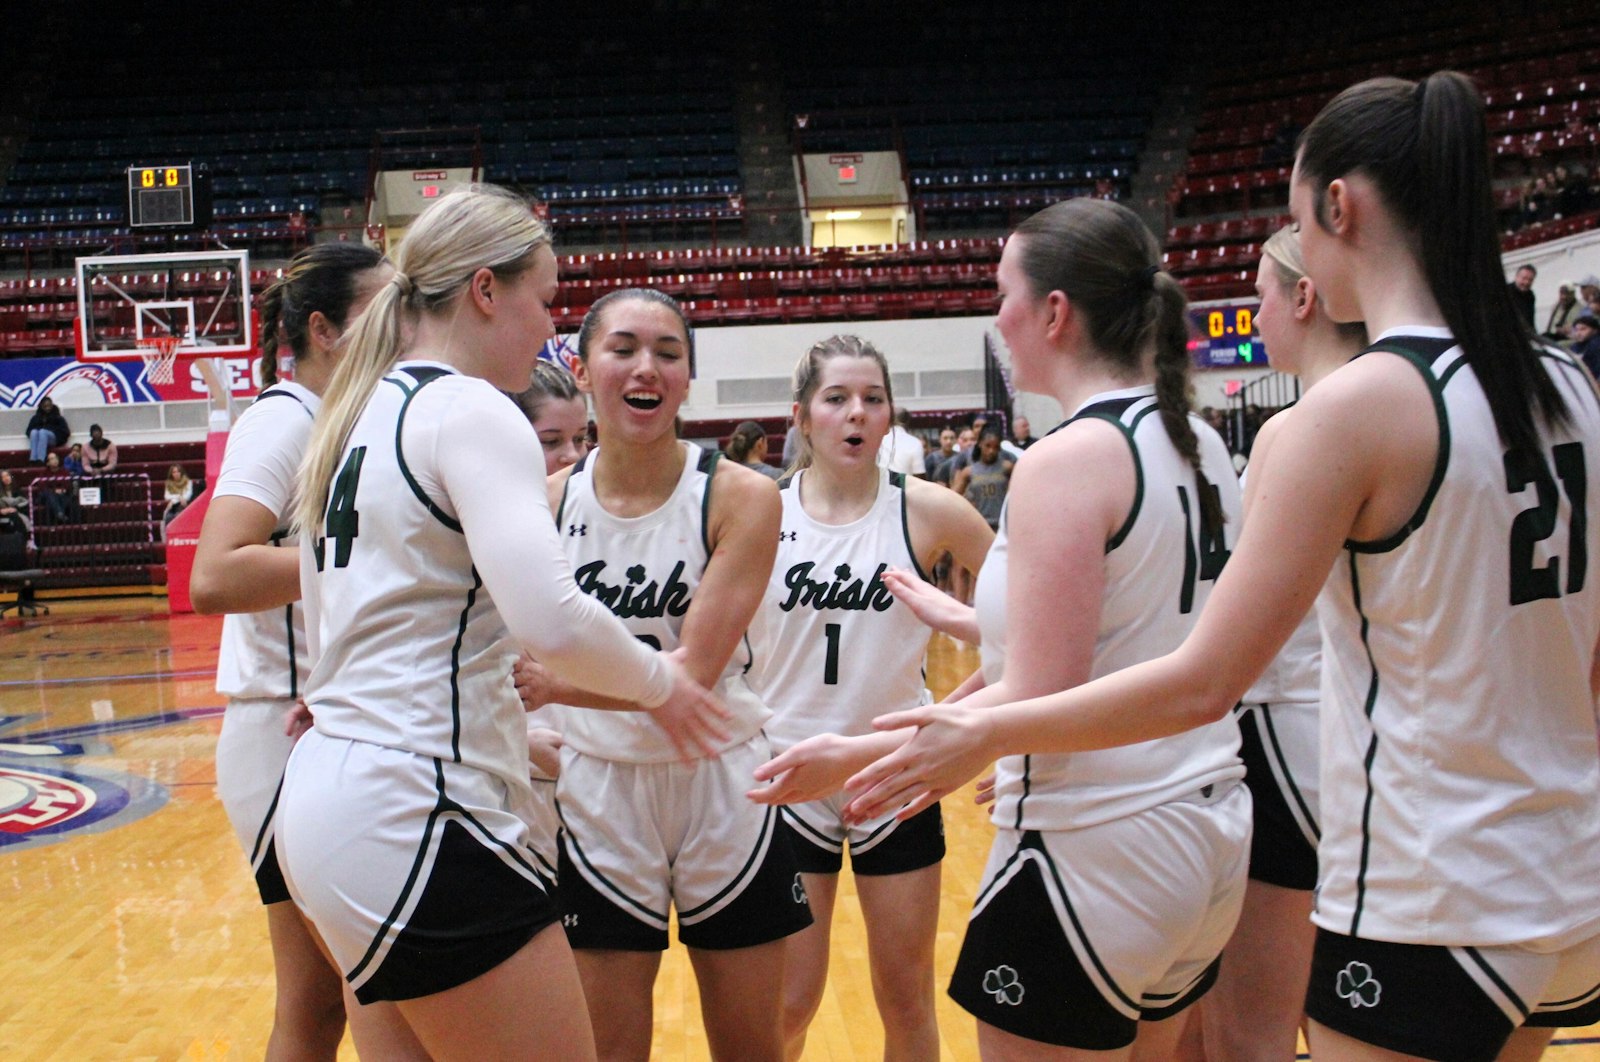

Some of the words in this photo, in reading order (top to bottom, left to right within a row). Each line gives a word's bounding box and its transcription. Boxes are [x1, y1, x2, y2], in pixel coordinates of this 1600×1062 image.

[1208, 309, 1252, 338] 0.0
[1238, 342, 1253, 363] 4
[312, 445, 367, 573] 4
[1503, 441, 1588, 606] 21
[1176, 484, 1232, 615] 14
[574, 560, 692, 618] Irish
[779, 561, 894, 612] Irish
[824, 623, 841, 685] 1
